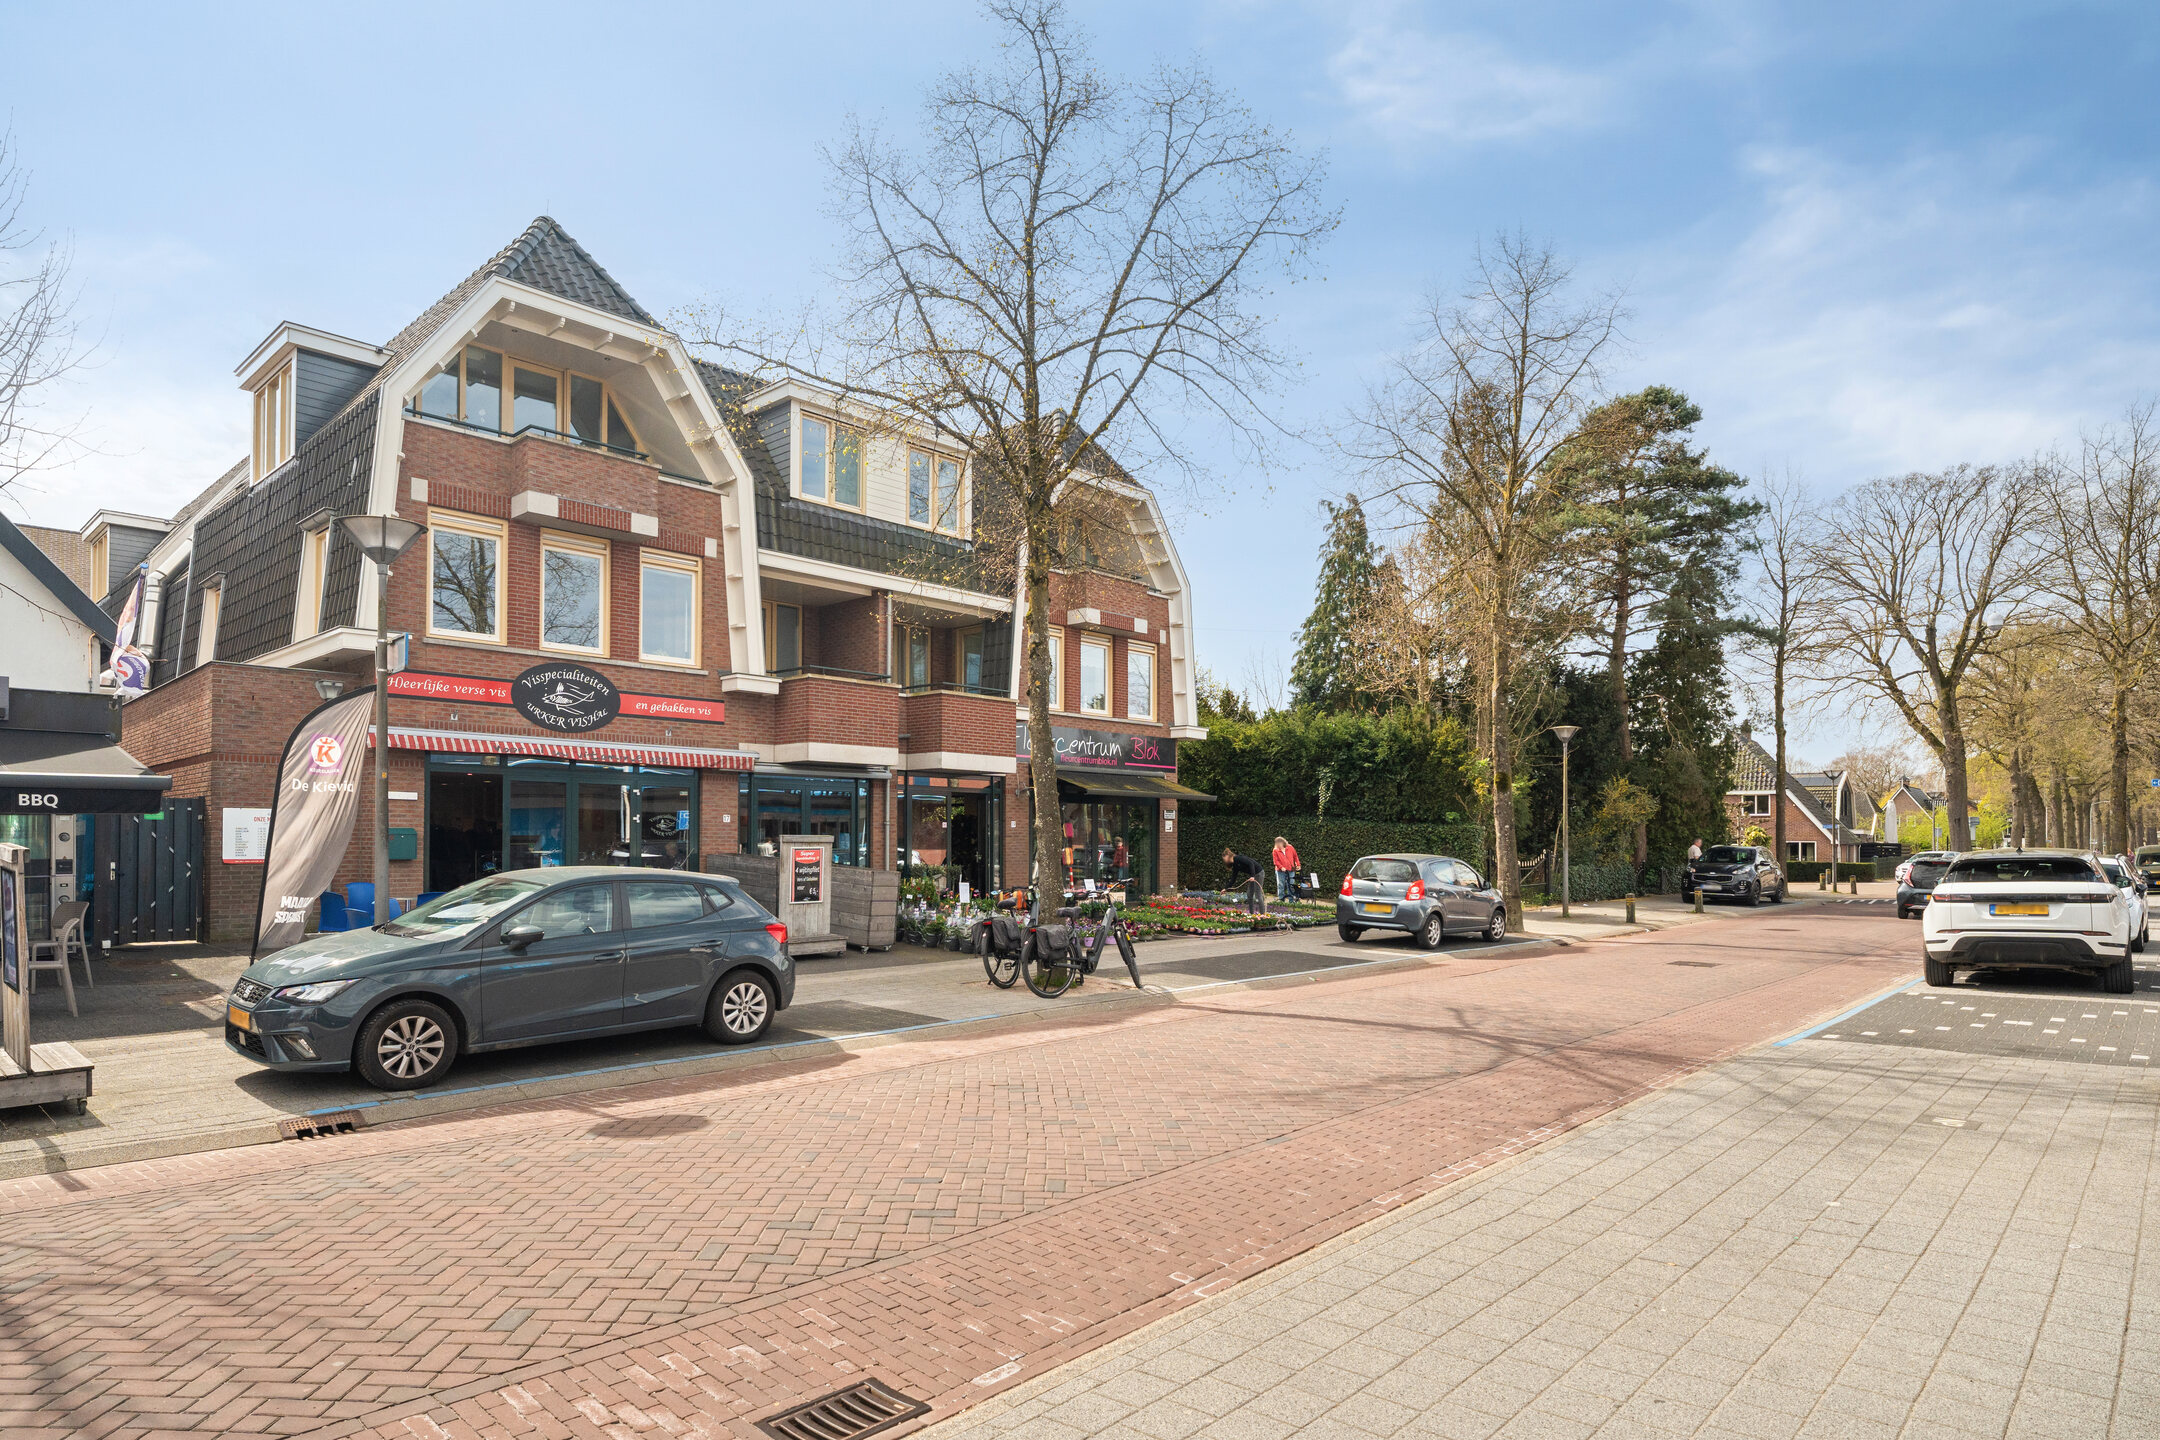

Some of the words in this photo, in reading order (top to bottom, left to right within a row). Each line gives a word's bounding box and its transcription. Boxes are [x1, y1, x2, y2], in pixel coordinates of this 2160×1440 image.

[387, 676, 450, 694] Heerlijke
[453, 685, 486, 697] verse
[488, 687, 507, 698] vis
[521, 669, 610, 696] Visspecialiteiten
[526, 702, 567, 729] URKER
[635, 702, 648, 710] en
[649, 702, 696, 714] gebakken
[697, 706, 712, 716] vis
[1130, 736, 1161, 761] Blok
[1060, 753, 1118, 766] fleurcentrumblok.nl
[292, 778, 309, 792] De
[18, 793, 59, 809] BBQ
